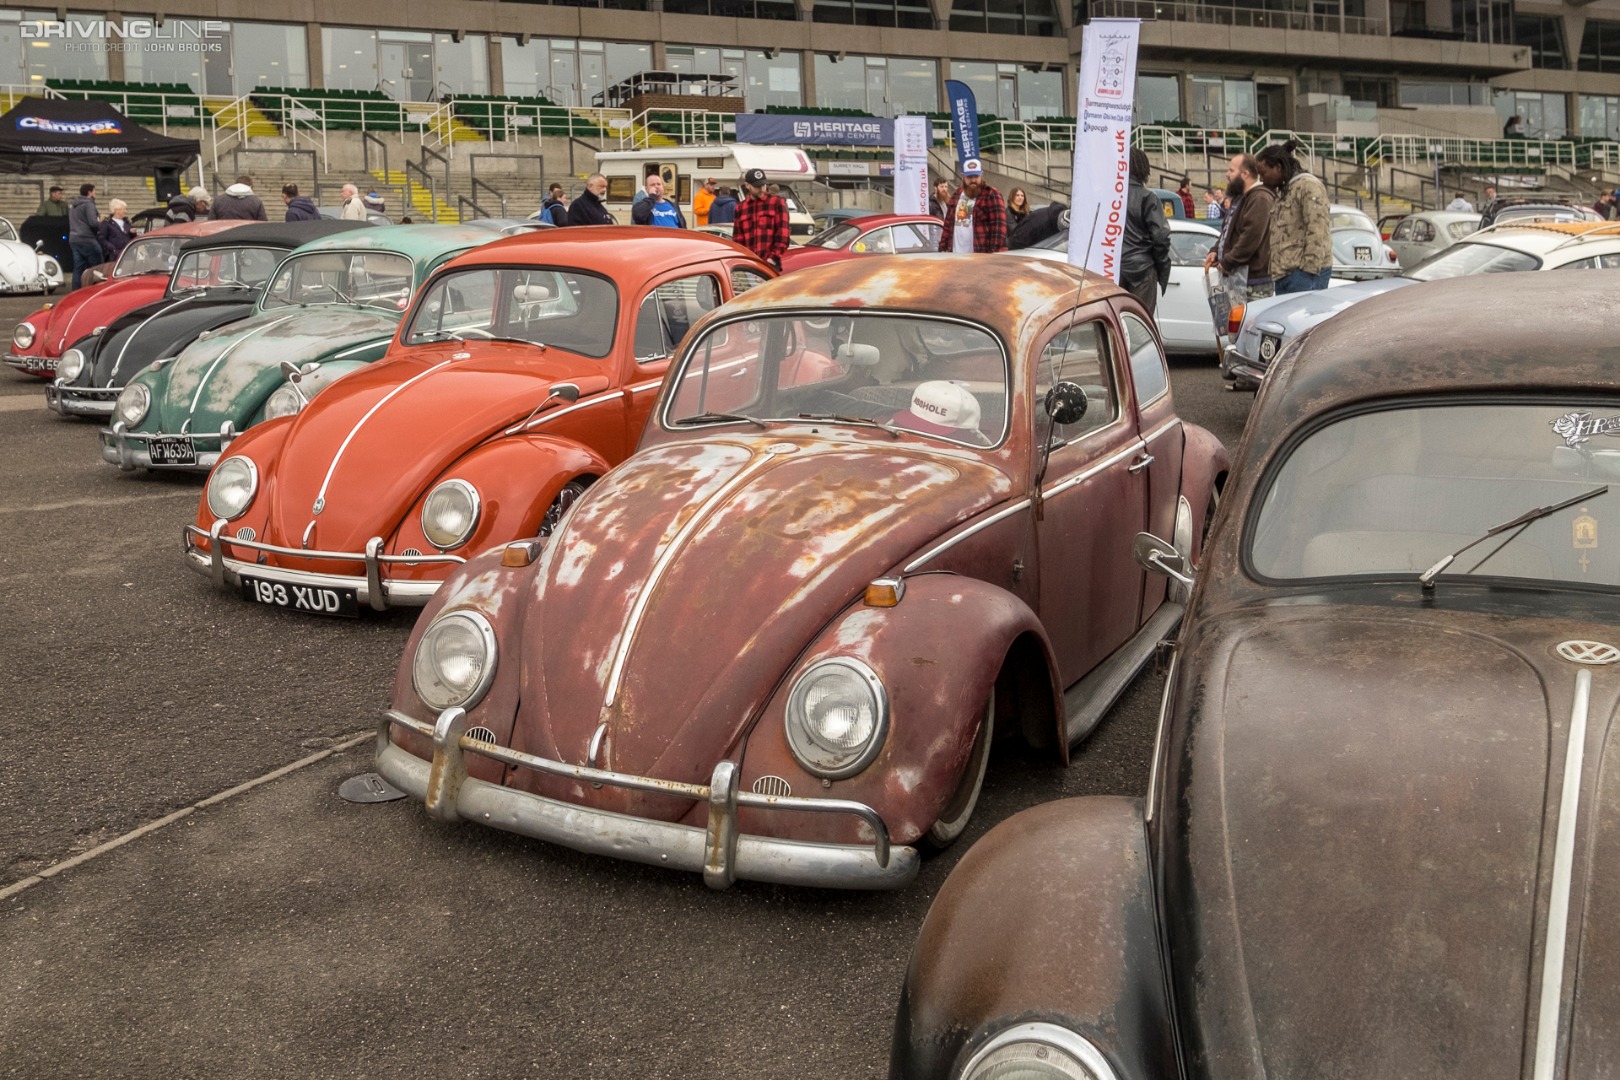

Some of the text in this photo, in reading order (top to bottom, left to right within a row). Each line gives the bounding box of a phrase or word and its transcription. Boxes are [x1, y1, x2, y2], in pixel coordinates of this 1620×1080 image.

[19, 117, 116, 134] Camper
[813, 122, 881, 133] HERITAGE
[956, 98, 972, 158] HERITAGE
[813, 131, 881, 140] PARTS CENTRE
[21, 145, 128, 154] www.vwcamperandbus.com
[26, 359, 46, 371] SCK
[913, 396, 948, 417] ASSHOLE
[150, 443, 194, 459] AFW639A
[253, 579, 340, 613] 193 XUD
